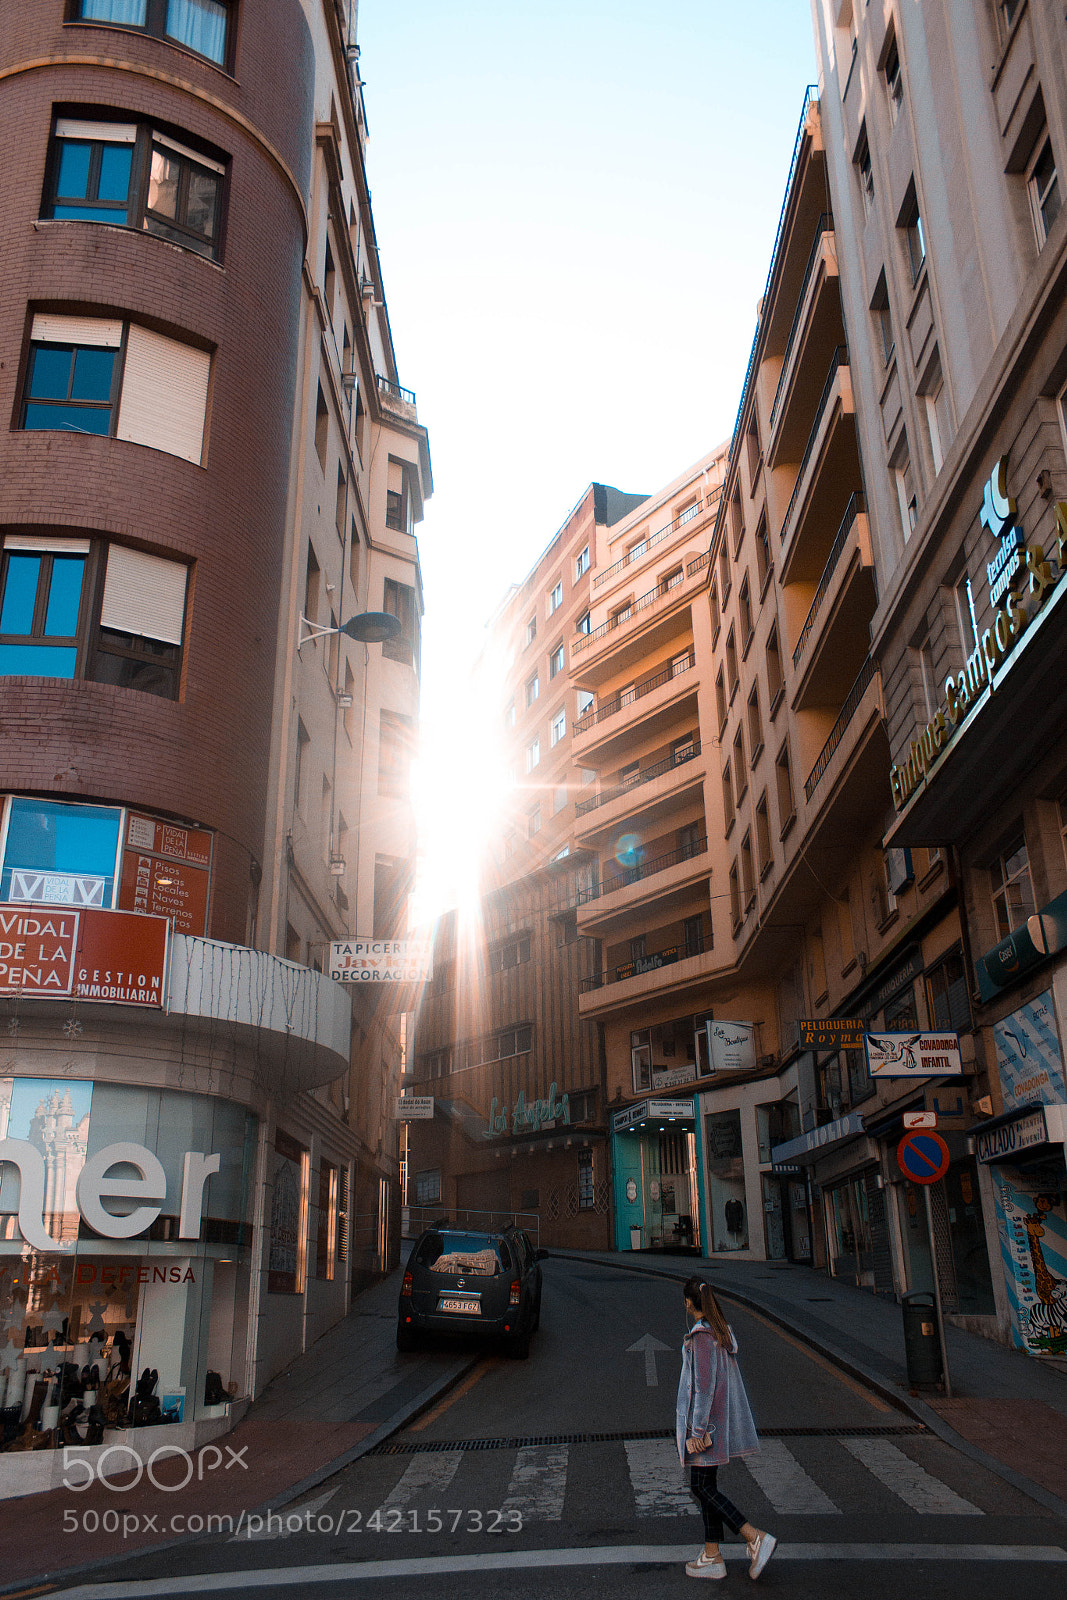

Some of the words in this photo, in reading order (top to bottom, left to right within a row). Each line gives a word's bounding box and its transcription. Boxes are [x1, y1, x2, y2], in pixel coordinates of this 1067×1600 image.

[990, 548, 1020, 608] campos
[890, 708, 946, 811] Enrique
[945, 592, 1026, 724] Campos
[165, 828, 185, 840] VIDAL
[165, 836, 175, 845] DE
[175, 838, 185, 847] LA
[155, 861, 180, 876] Pisos
[46, 877, 70, 887] VIDAL
[154, 872, 185, 887] Casas
[45, 885, 56, 893] DE
[59, 886, 69, 895] LA
[153, 881, 189, 898] Locales
[152, 892, 184, 907] Naves
[151, 901, 193, 919] Terrenos
[0, 913, 70, 938] VIDAL
[0, 941, 26, 961] DE
[39, 944, 67, 964] LA
[338, 955, 417, 969] Javier
[636, 954, 663, 974] Adolfo
[78, 968, 160, 988] GESTION
[331, 970, 432, 981] DECORACION
[77, 984, 158, 1003] INMOBILIARIA
[800, 1019, 864, 1031] PELUQUERIA
[805, 1032, 863, 1046] Royma
[919, 1039, 959, 1051] COVADONGA
[921, 1056, 951, 1068] INFANTIL
[1014, 1071, 1048, 1097] COVADONGA
[482, 1096, 507, 1138] Los
[978, 1125, 1016, 1160] CALZADO
[22, 1264, 62, 1285] LA
[76, 1264, 196, 1285] DEFENSA
[444, 1301, 462, 1310] 4653
[463, 1302, 477, 1311] FGZ
